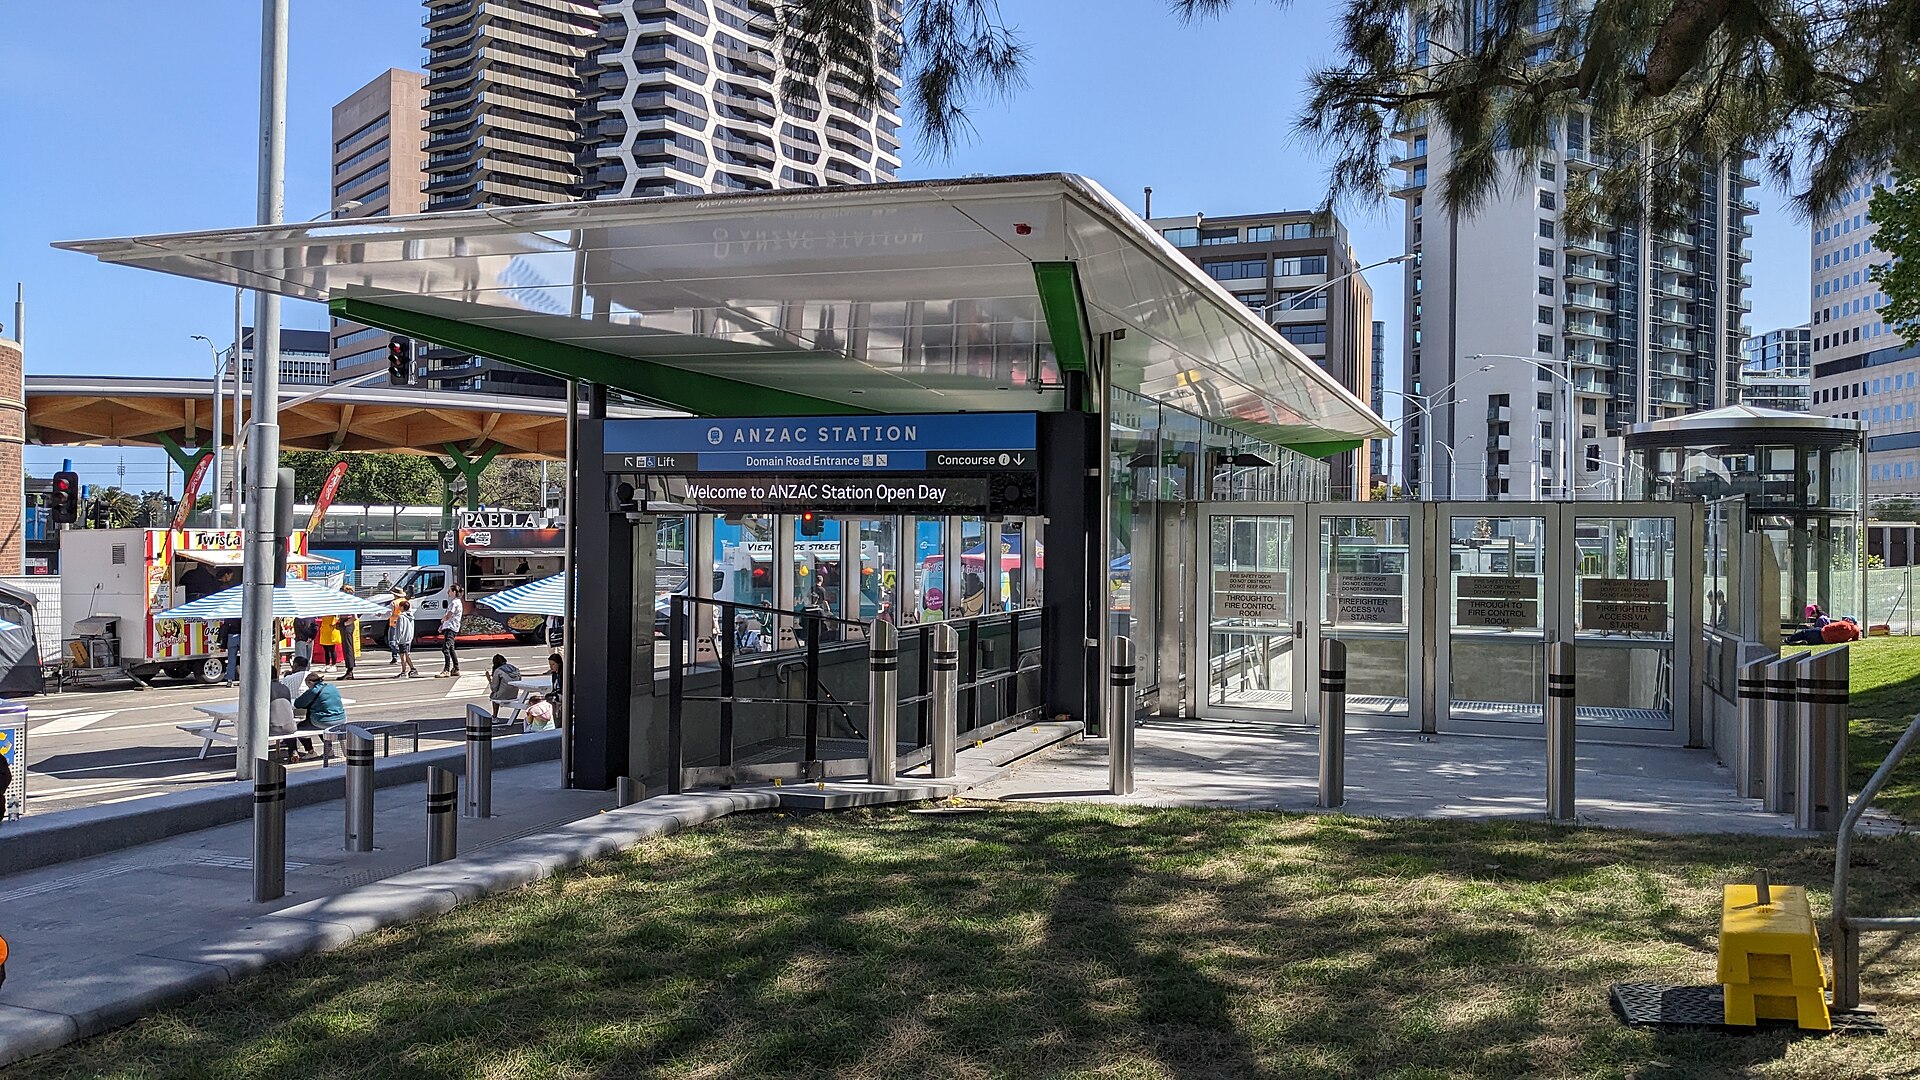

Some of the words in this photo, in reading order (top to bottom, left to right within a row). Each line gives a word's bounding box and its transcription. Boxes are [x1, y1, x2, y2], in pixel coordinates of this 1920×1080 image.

[734, 427, 807, 443] ANZAC
[818, 425, 917, 441] STATION
[657, 457, 675, 467] Lift
[746, 456, 783, 466] Domain
[786, 456, 811, 466] Road
[814, 456, 859, 466] Entrance
[937, 454, 995, 465] Concourse
[685, 485, 747, 499] Welcome
[751, 486, 764, 499] to
[768, 484, 817, 499] ANZAC
[821, 484, 872, 499] Station
[876, 484, 915, 503] Open
[919, 484, 946, 503] Day
[463, 513, 538, 528] PAELLA
[195, 533, 241, 547] Twista
[808, 543, 840, 551] STREET
[1471, 601, 1509, 609] THROUGH
[1596, 605, 1651, 613] FIREFIGHTER
[1488, 609, 1526, 617] CONTROL
[1599, 613, 1633, 621] ACCESS
